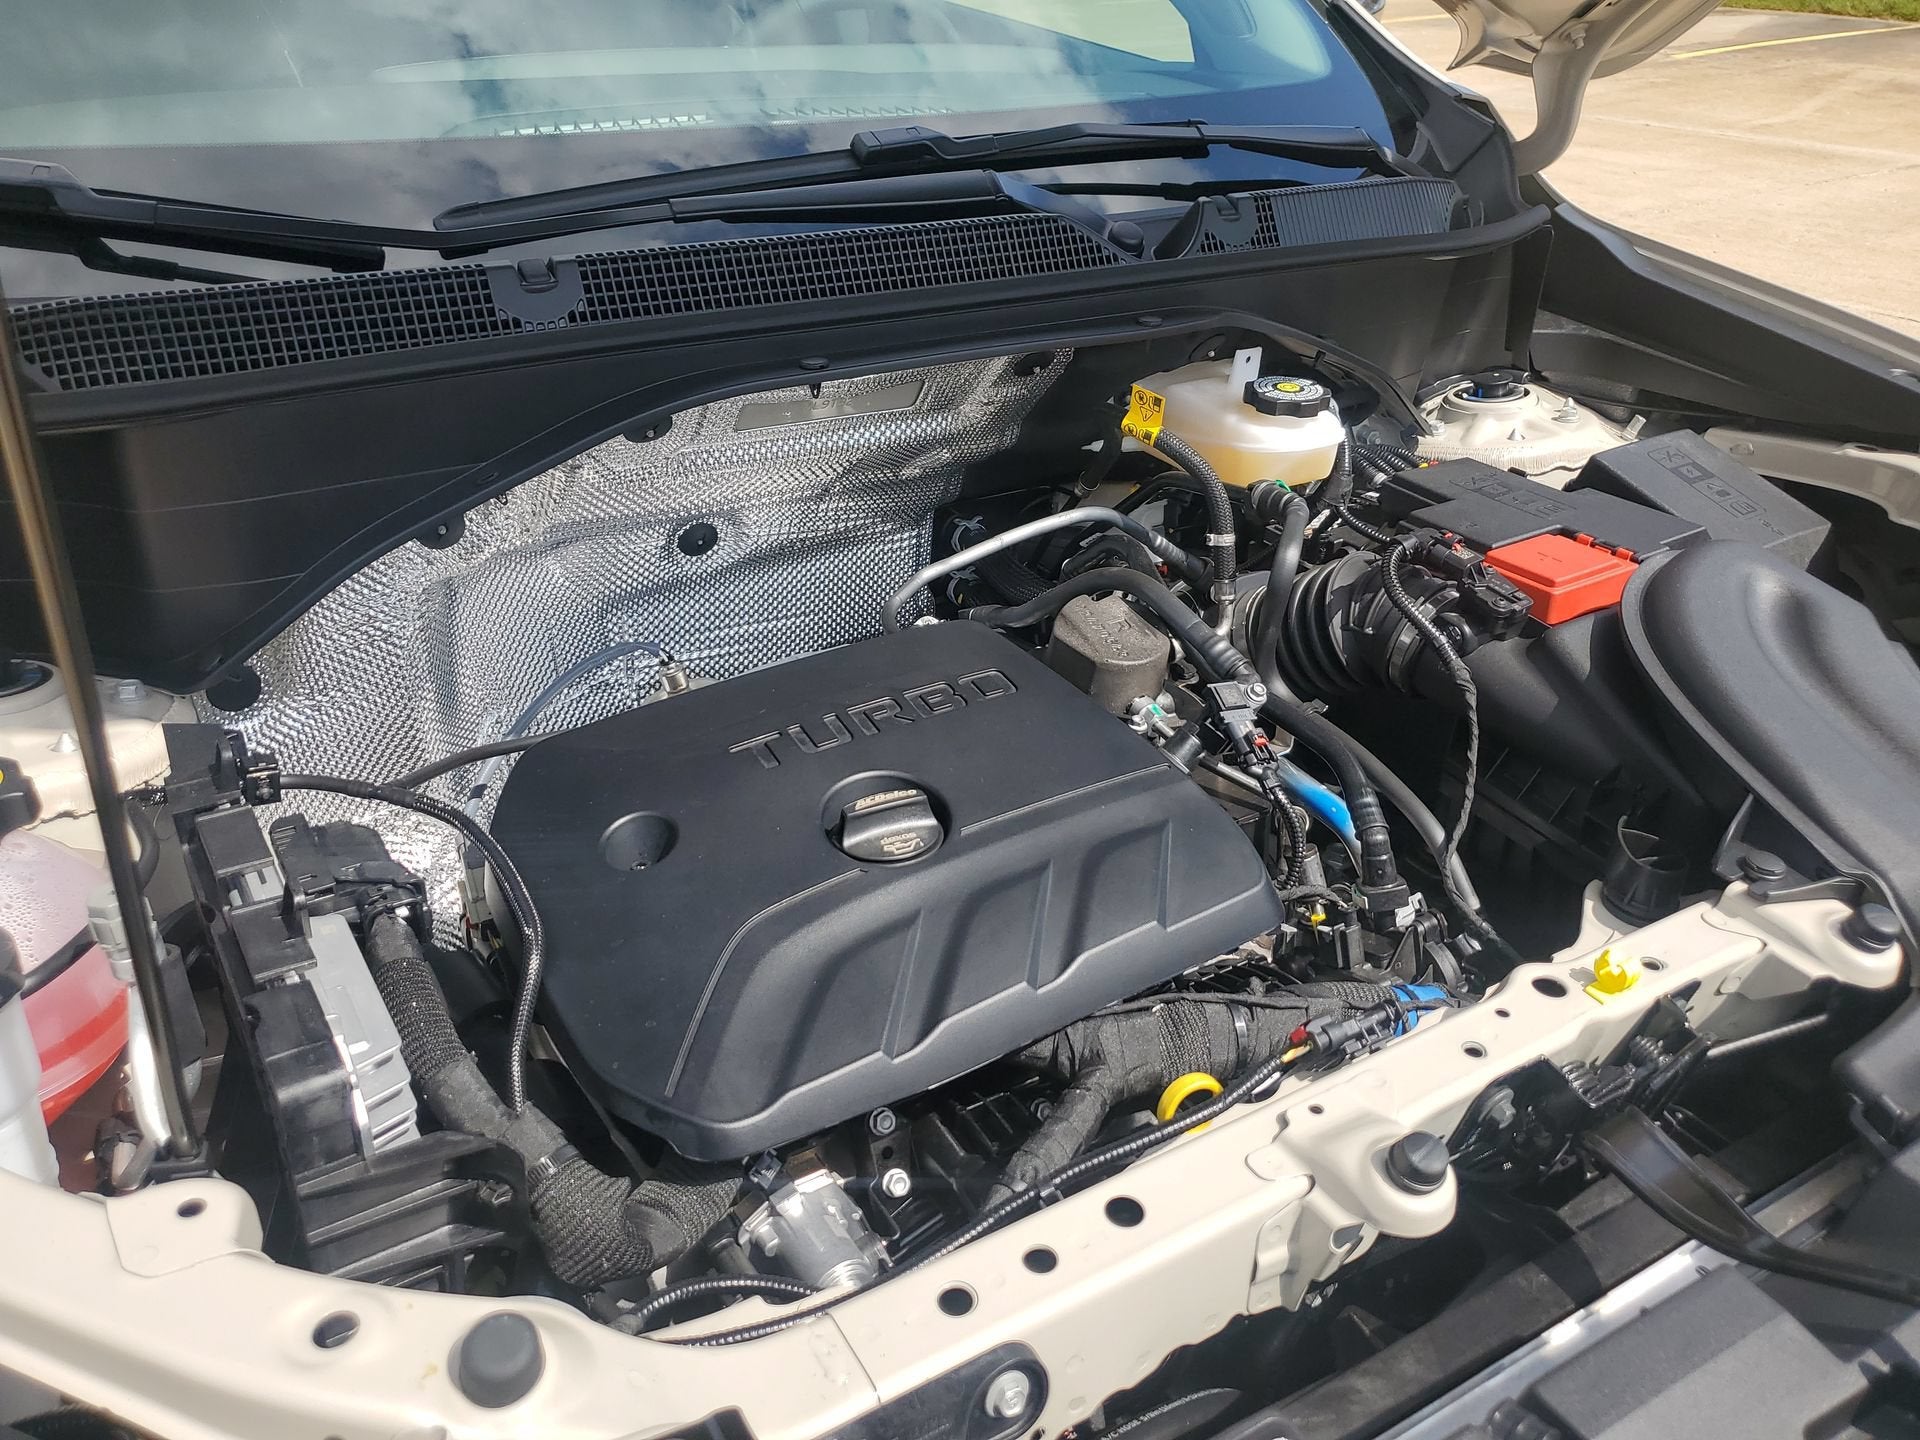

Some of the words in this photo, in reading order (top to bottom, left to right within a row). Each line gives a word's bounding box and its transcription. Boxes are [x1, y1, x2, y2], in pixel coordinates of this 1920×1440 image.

[728, 668, 1018, 769] TURBO
[854, 789, 918, 811] ACDelco
[880, 832, 918, 845] dexos
